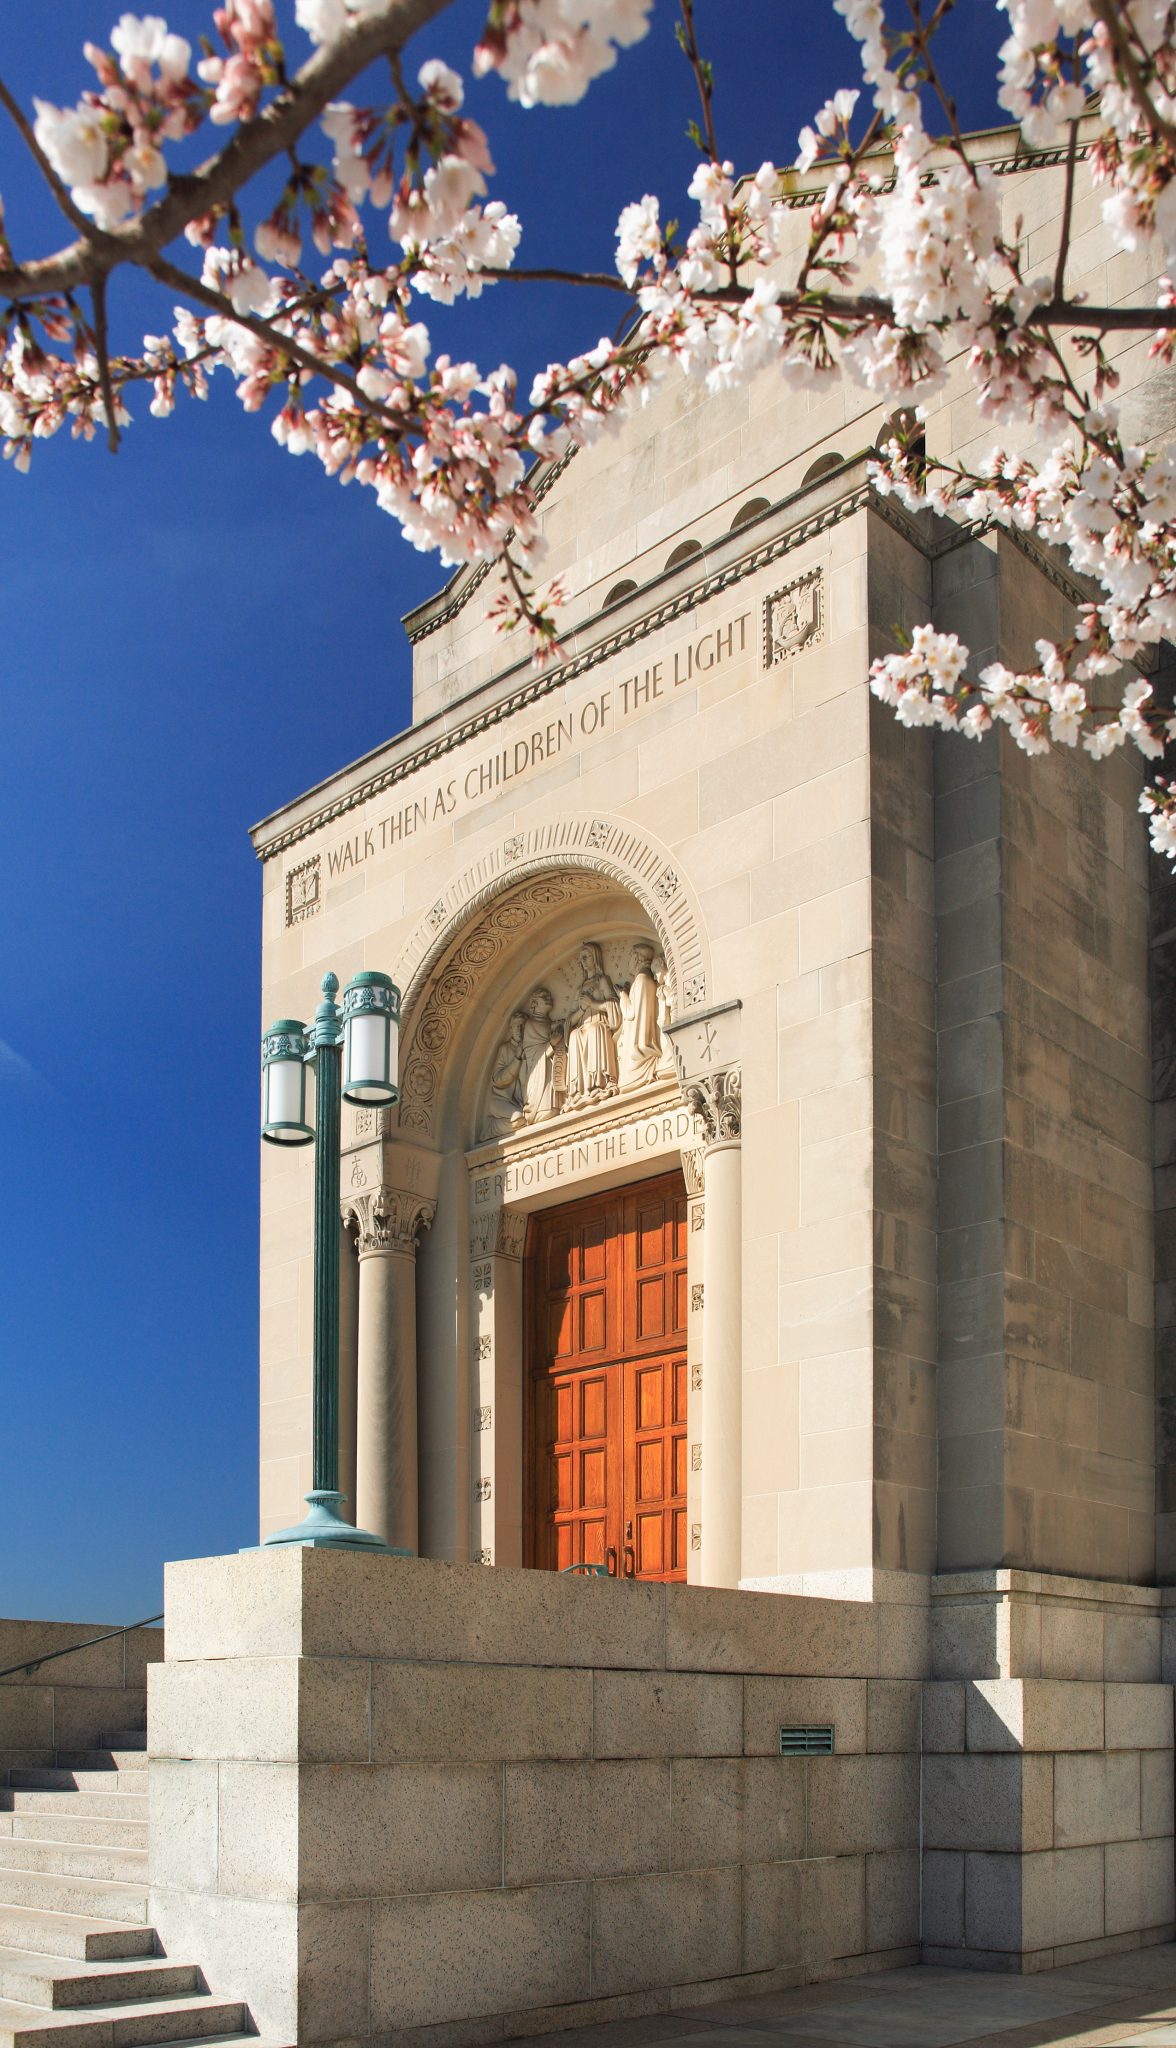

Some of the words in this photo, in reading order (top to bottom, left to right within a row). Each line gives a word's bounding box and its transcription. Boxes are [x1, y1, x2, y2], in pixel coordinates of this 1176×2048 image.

[327, 827, 375, 878] WALK
[378, 796, 427, 850] THEN
[432, 779, 457, 822] AS
[464, 713, 573, 800] CHILDREN
[580, 691, 611, 735] OF
[619, 661, 664, 715] THE
[674, 611, 752, 687] LIGHT
[494, 1153, 565, 1196] REJOICE
[571, 1144, 589, 1172] IN
[593, 1131, 627, 1163] THE
[635, 1113, 690, 1150] LORD
